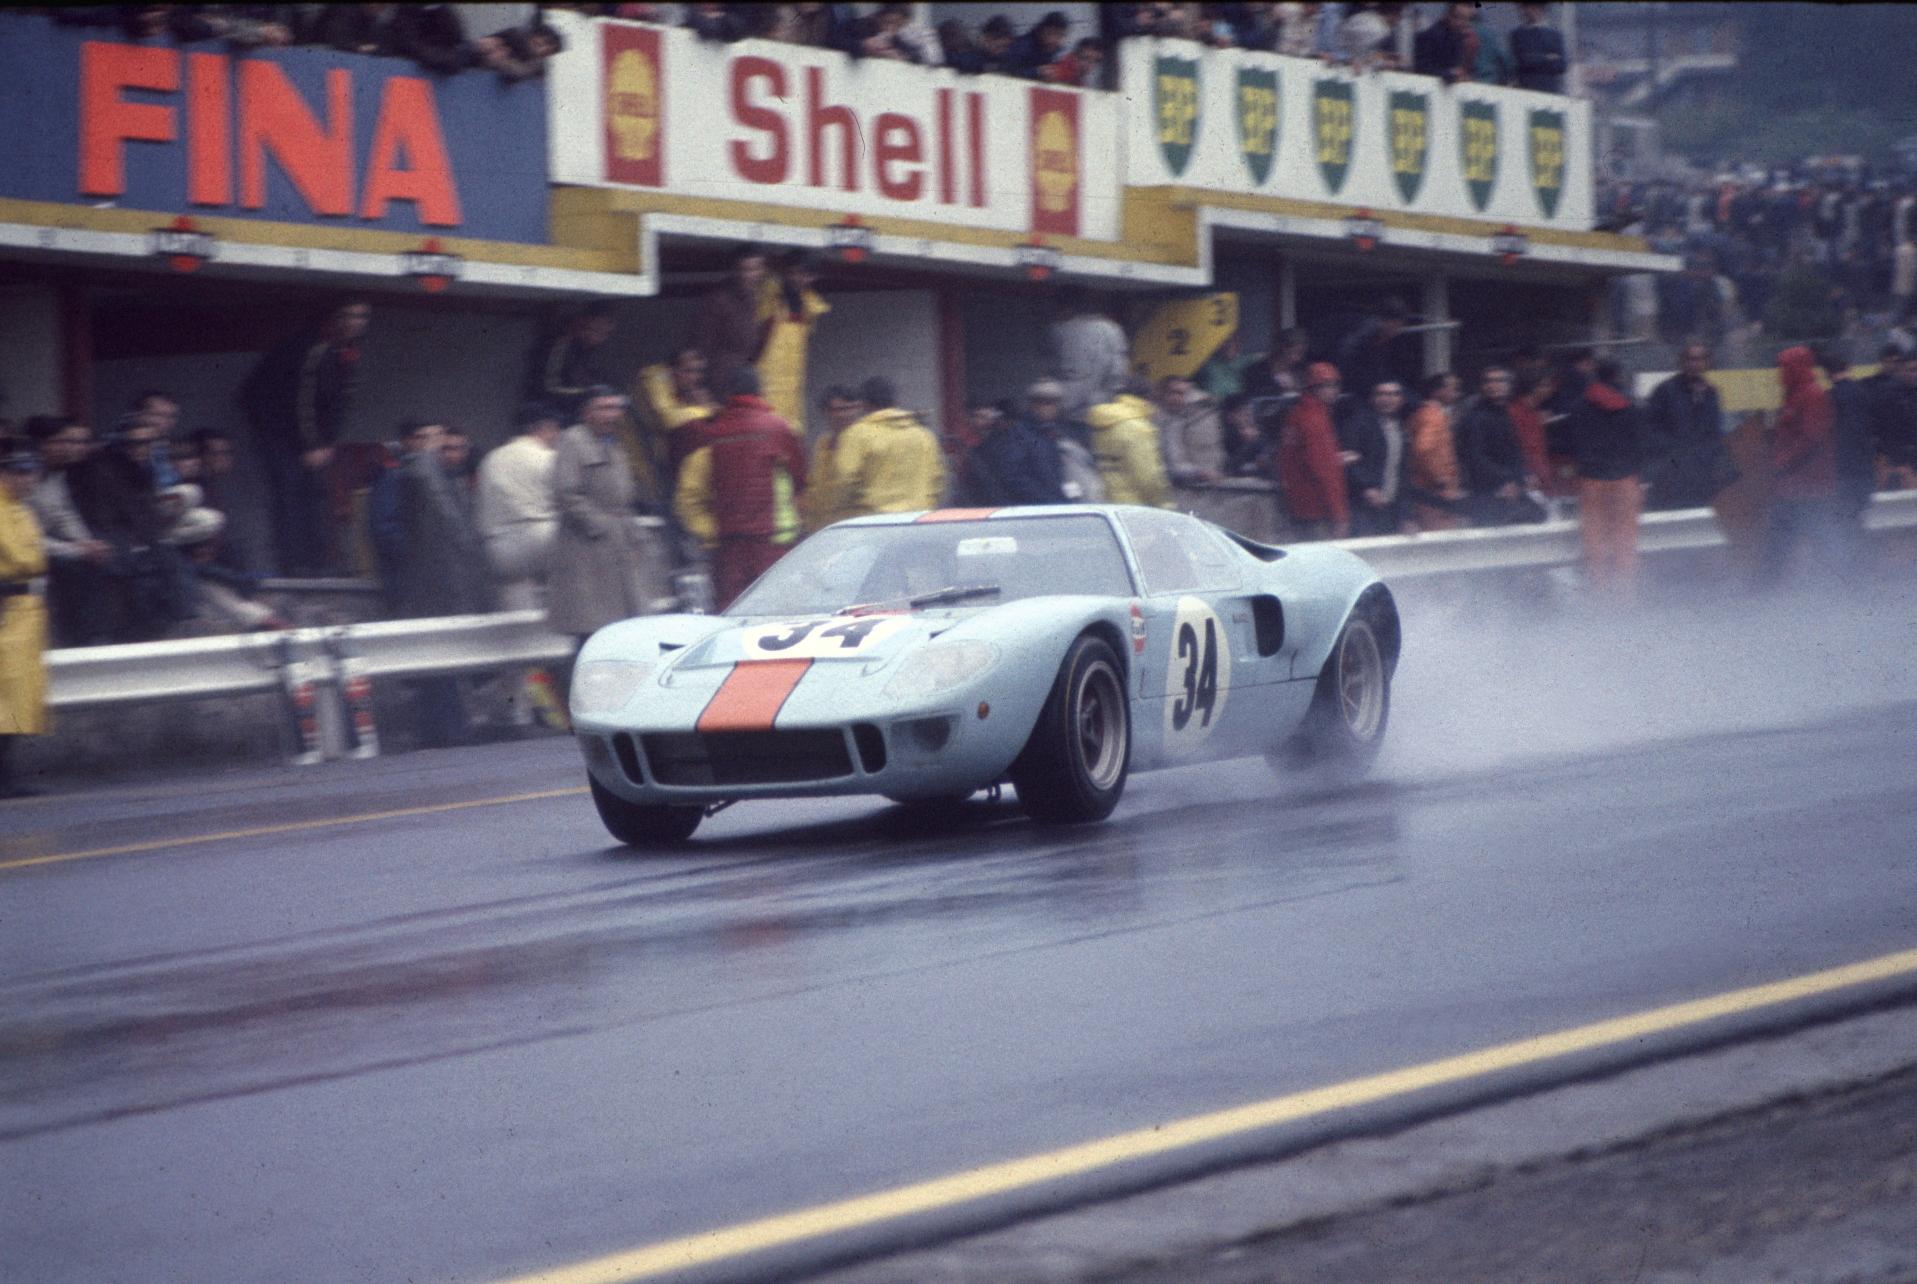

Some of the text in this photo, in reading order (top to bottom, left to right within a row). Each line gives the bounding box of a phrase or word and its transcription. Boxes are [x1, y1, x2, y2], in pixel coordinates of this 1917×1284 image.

[80, 40, 462, 226] FINA
[730, 55, 987, 208] Shell
[1173, 616, 1217, 731] 34
